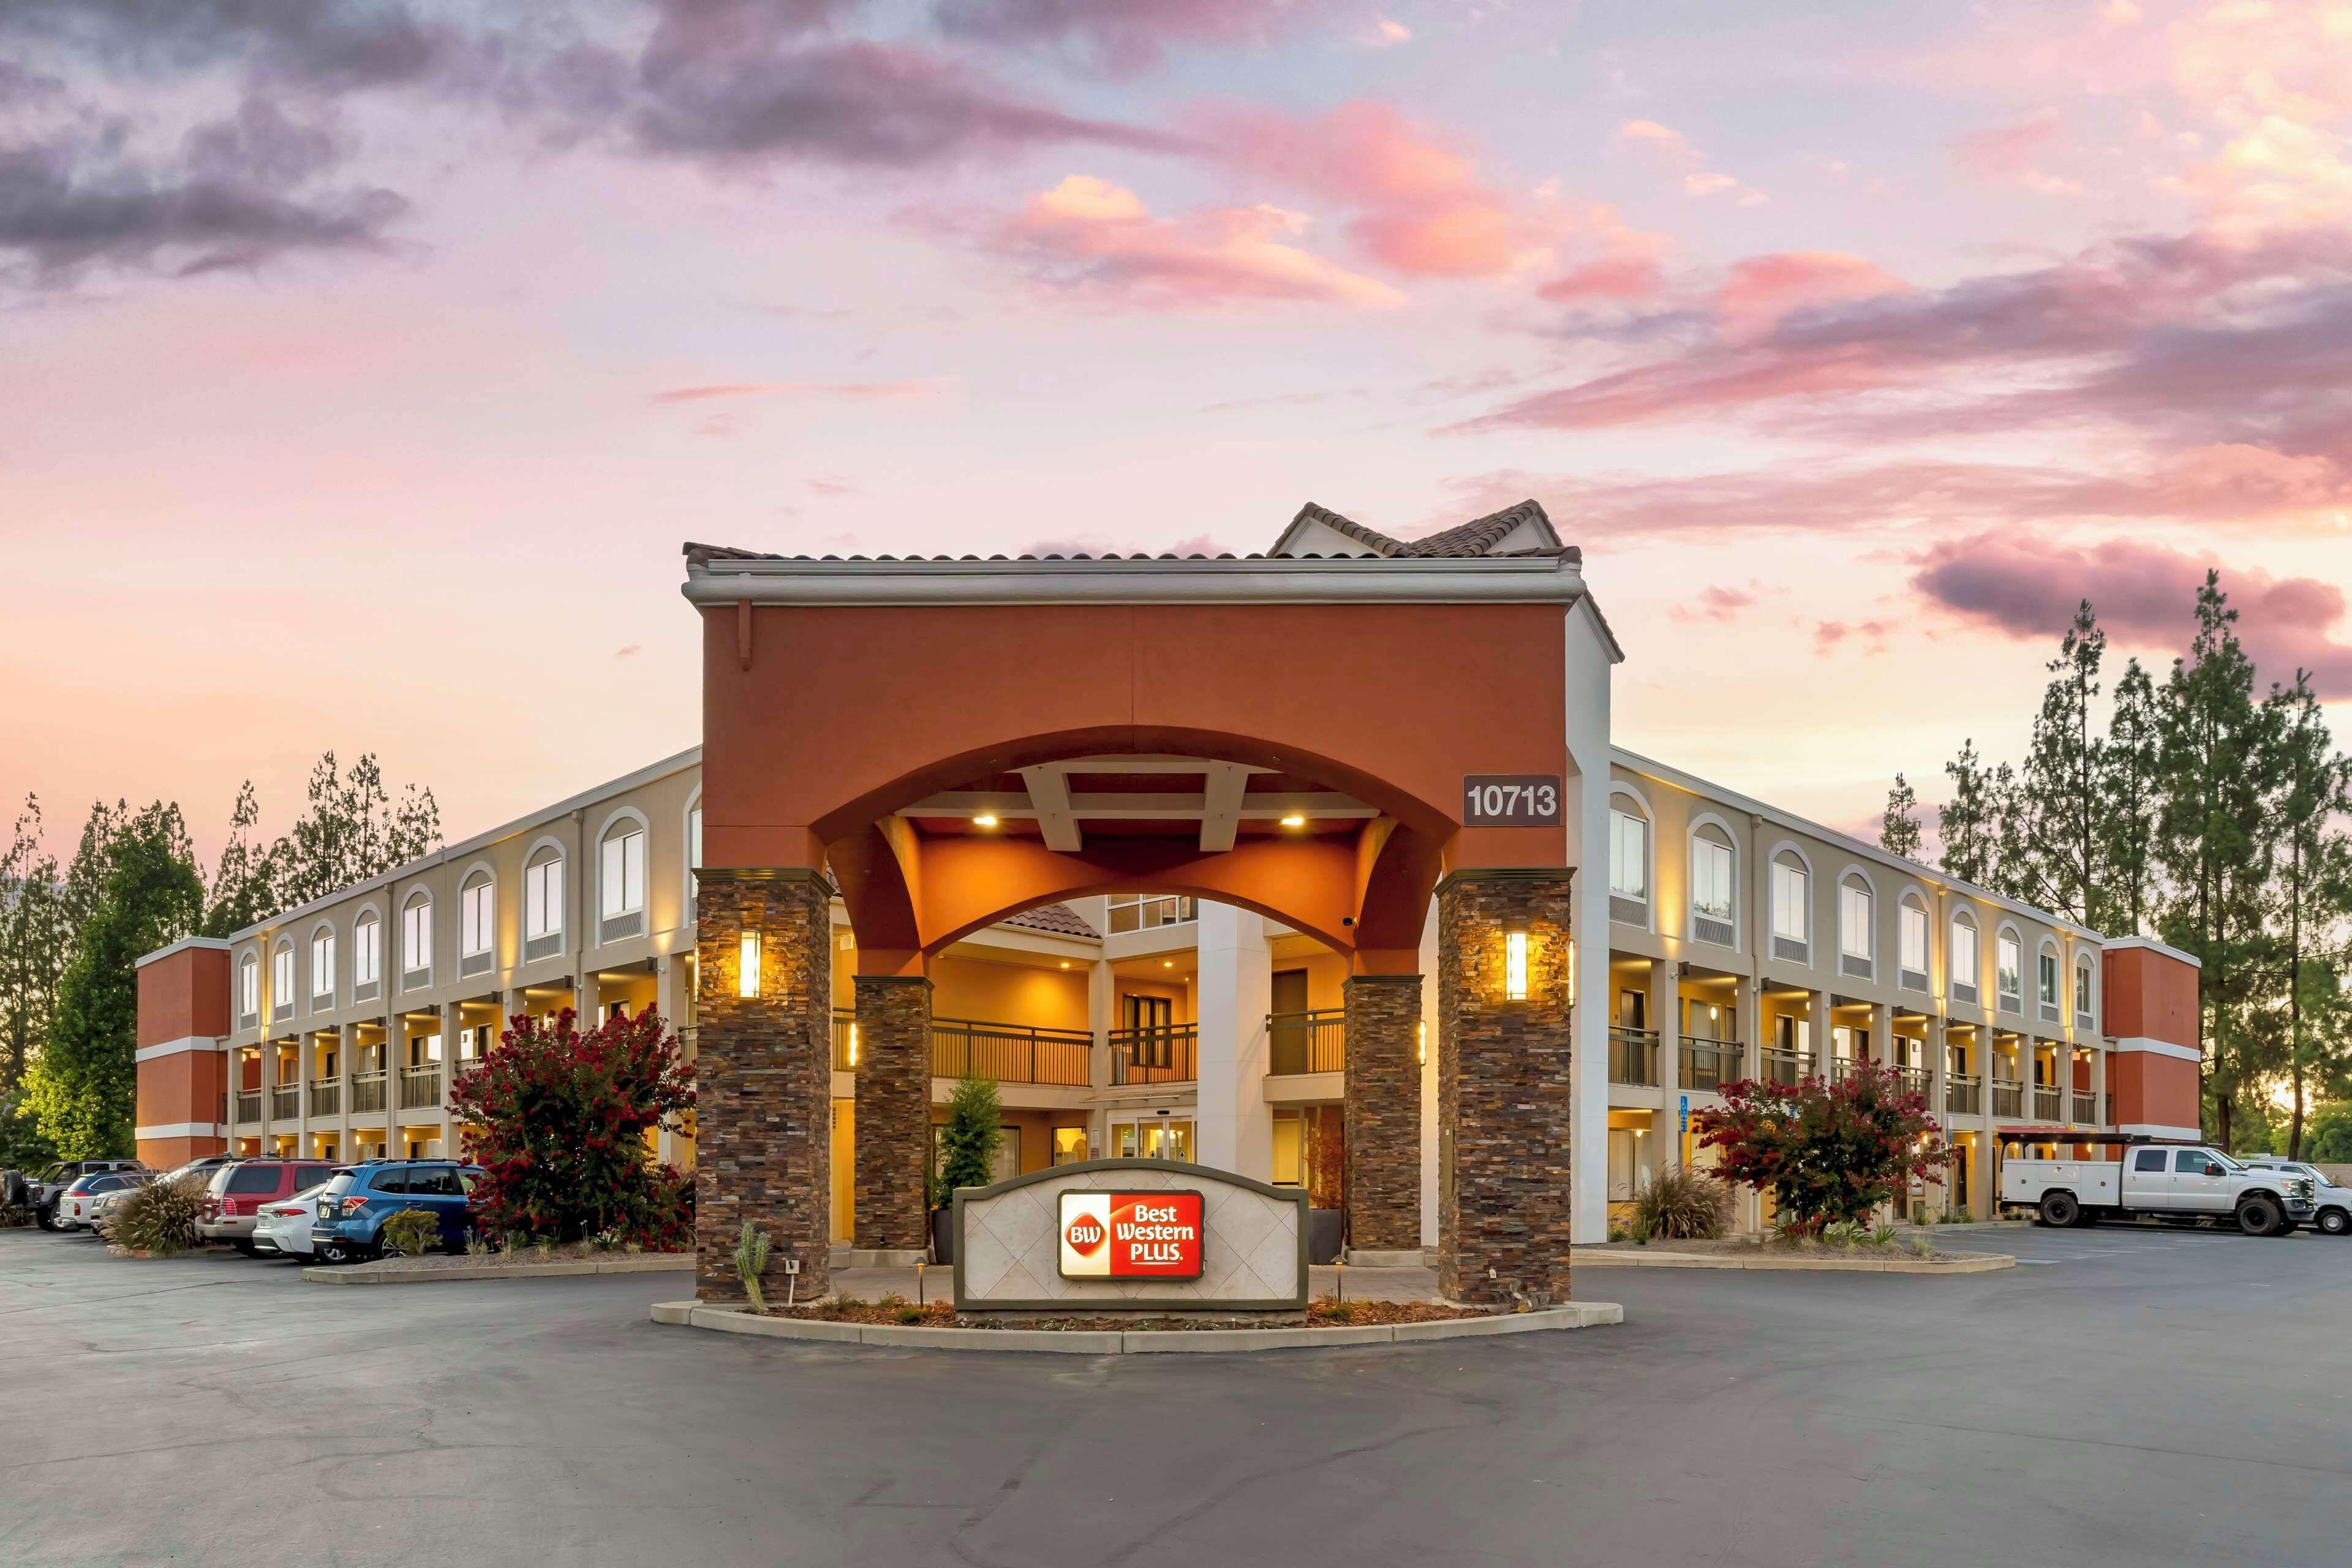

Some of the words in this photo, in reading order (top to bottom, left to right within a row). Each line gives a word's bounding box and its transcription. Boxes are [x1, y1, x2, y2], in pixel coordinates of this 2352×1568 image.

[1468, 785, 1556, 816] 10713
[1135, 1205, 1177, 1223] Best
[1071, 1226, 1101, 1243] BW
[1116, 1223, 1194, 1240] Western
